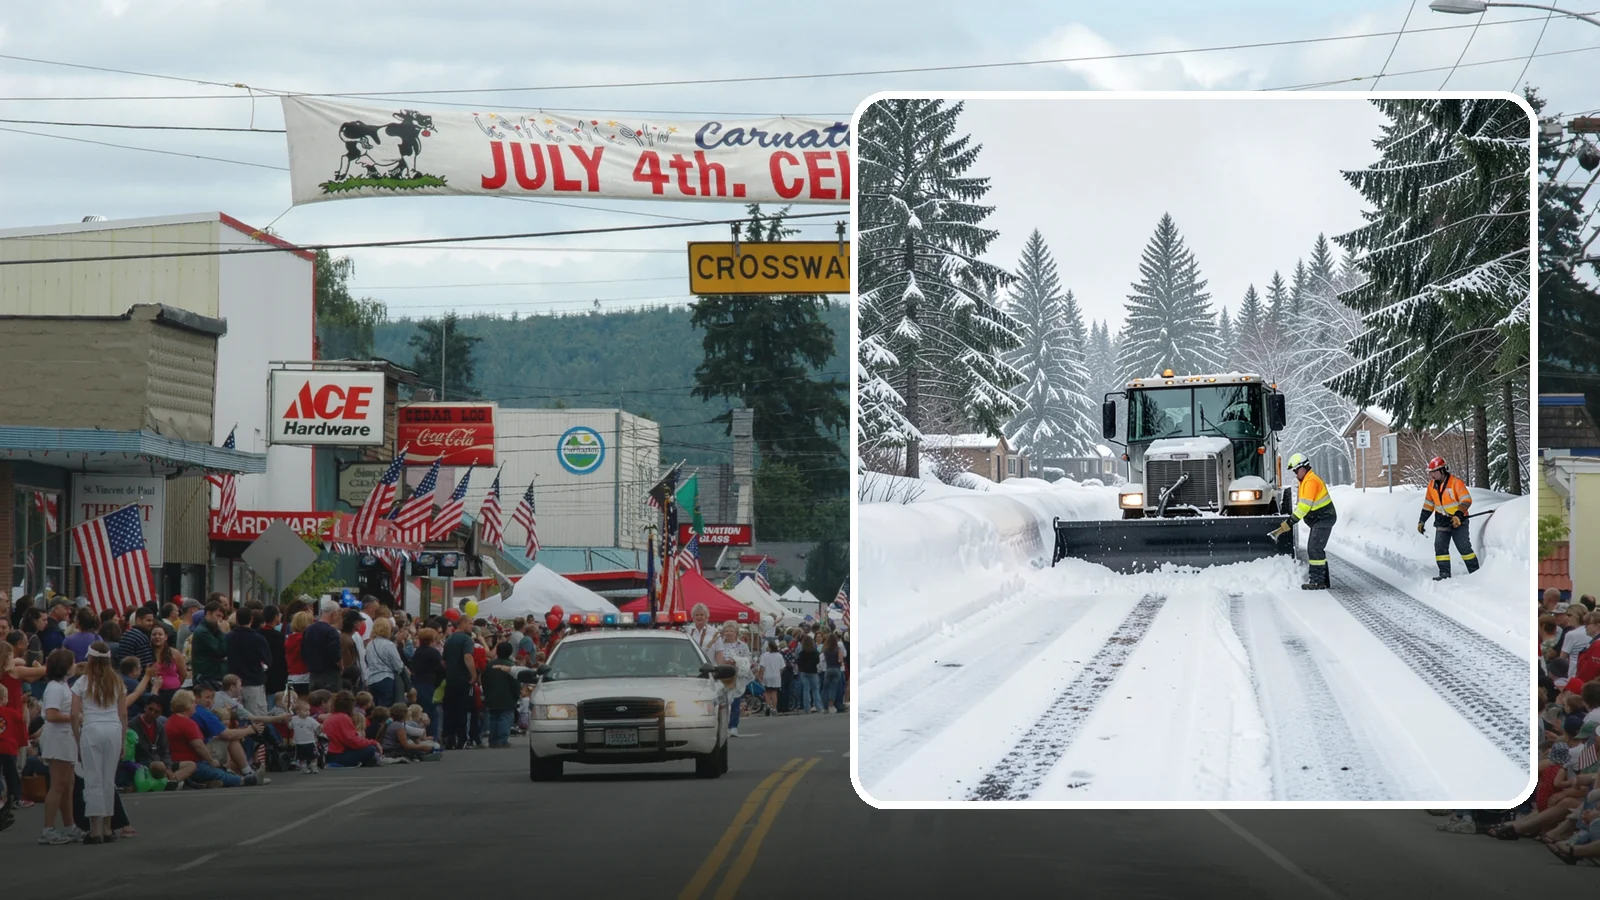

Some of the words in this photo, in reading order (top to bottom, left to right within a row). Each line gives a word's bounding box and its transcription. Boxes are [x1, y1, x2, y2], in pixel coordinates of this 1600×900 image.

[481, 140, 605, 193] JULY
[632, 150, 747, 198] 4th.
[697, 253, 850, 280] CROSSWA
[282, 380, 374, 420] ACE
[406, 409, 453, 422] CEDAR
[461, 409, 485, 422] LOG
[283, 421, 371, 437] Hardware
[354, 467, 384, 480] Simpl
[96, 485, 124, 495] Vincent
[126, 486, 136, 495] de
[138, 486, 155, 495] Paul
[213, 515, 331, 536] HARDARE
[688, 526, 742, 535] CRNATION
[699, 535, 730, 544] GLASS
